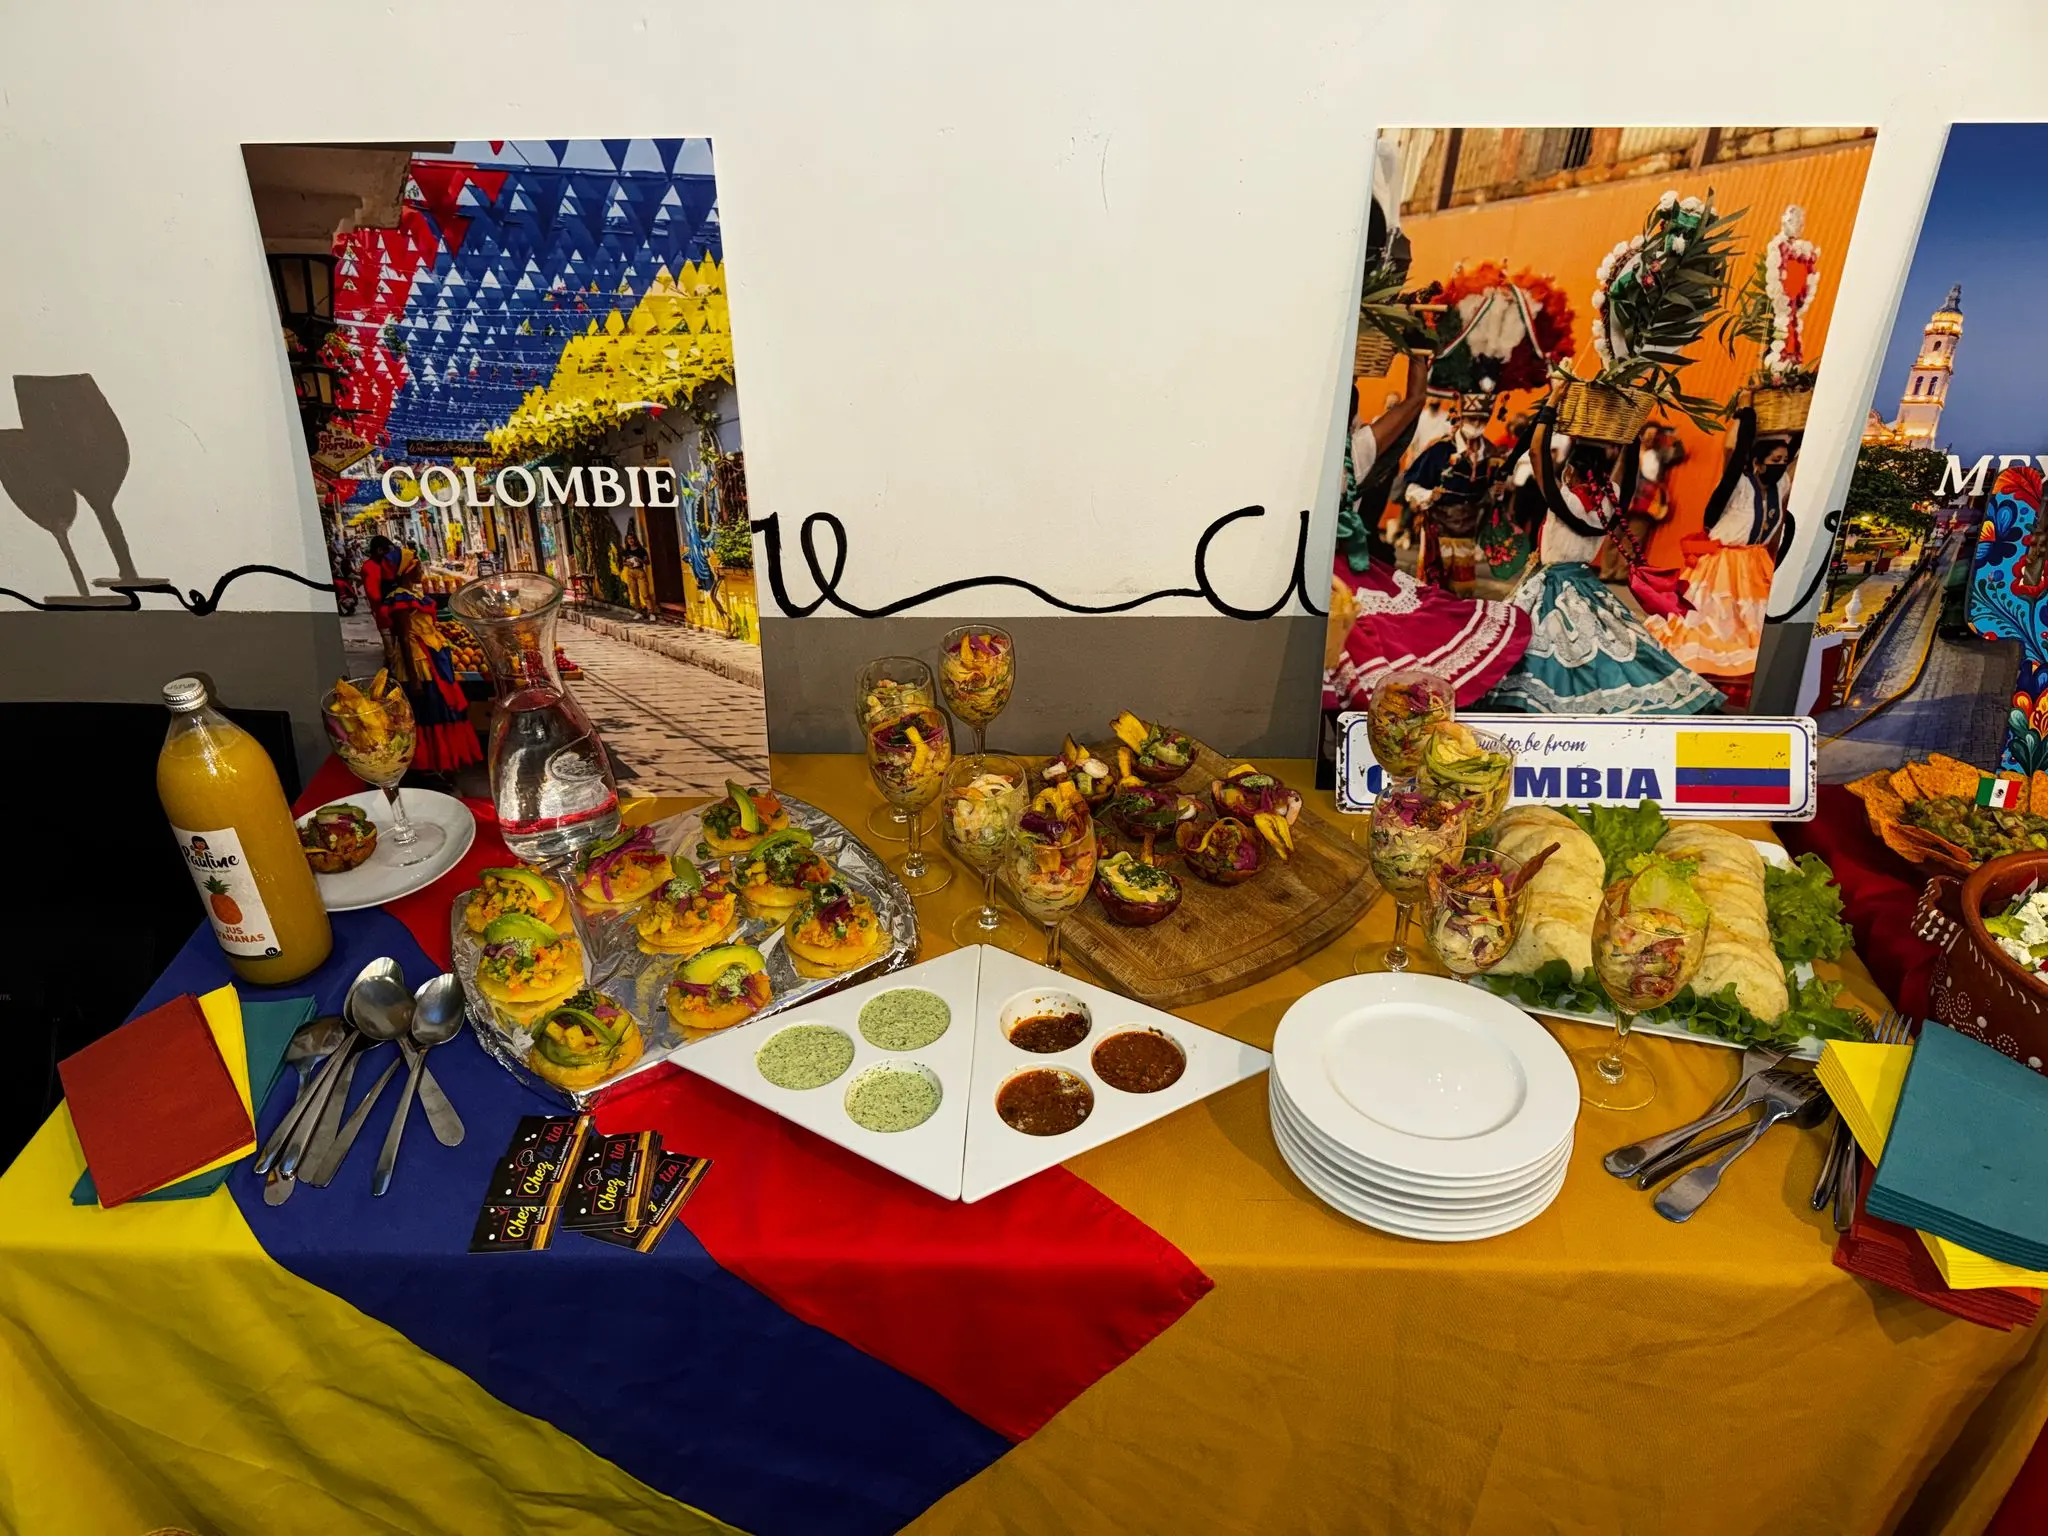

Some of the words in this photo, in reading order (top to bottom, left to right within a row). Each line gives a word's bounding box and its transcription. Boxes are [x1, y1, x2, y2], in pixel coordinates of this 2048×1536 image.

[381, 466, 679, 507] COLOMBIE
[1507, 737, 1521, 751] to
[1522, 732, 1541, 754] be
[1544, 735, 1587, 755] from
[181, 844, 240, 870] Pauline
[224, 926, 244, 935] JUS
[523, 1161, 555, 1194] Chez
[545, 1125, 565, 1143] tia
[609, 1143, 627, 1160] tia
[604, 1161, 623, 1177] la
[659, 1164, 680, 1183] tia
[598, 1178, 627, 1211] Chez
[507, 1206, 538, 1238] Chez
